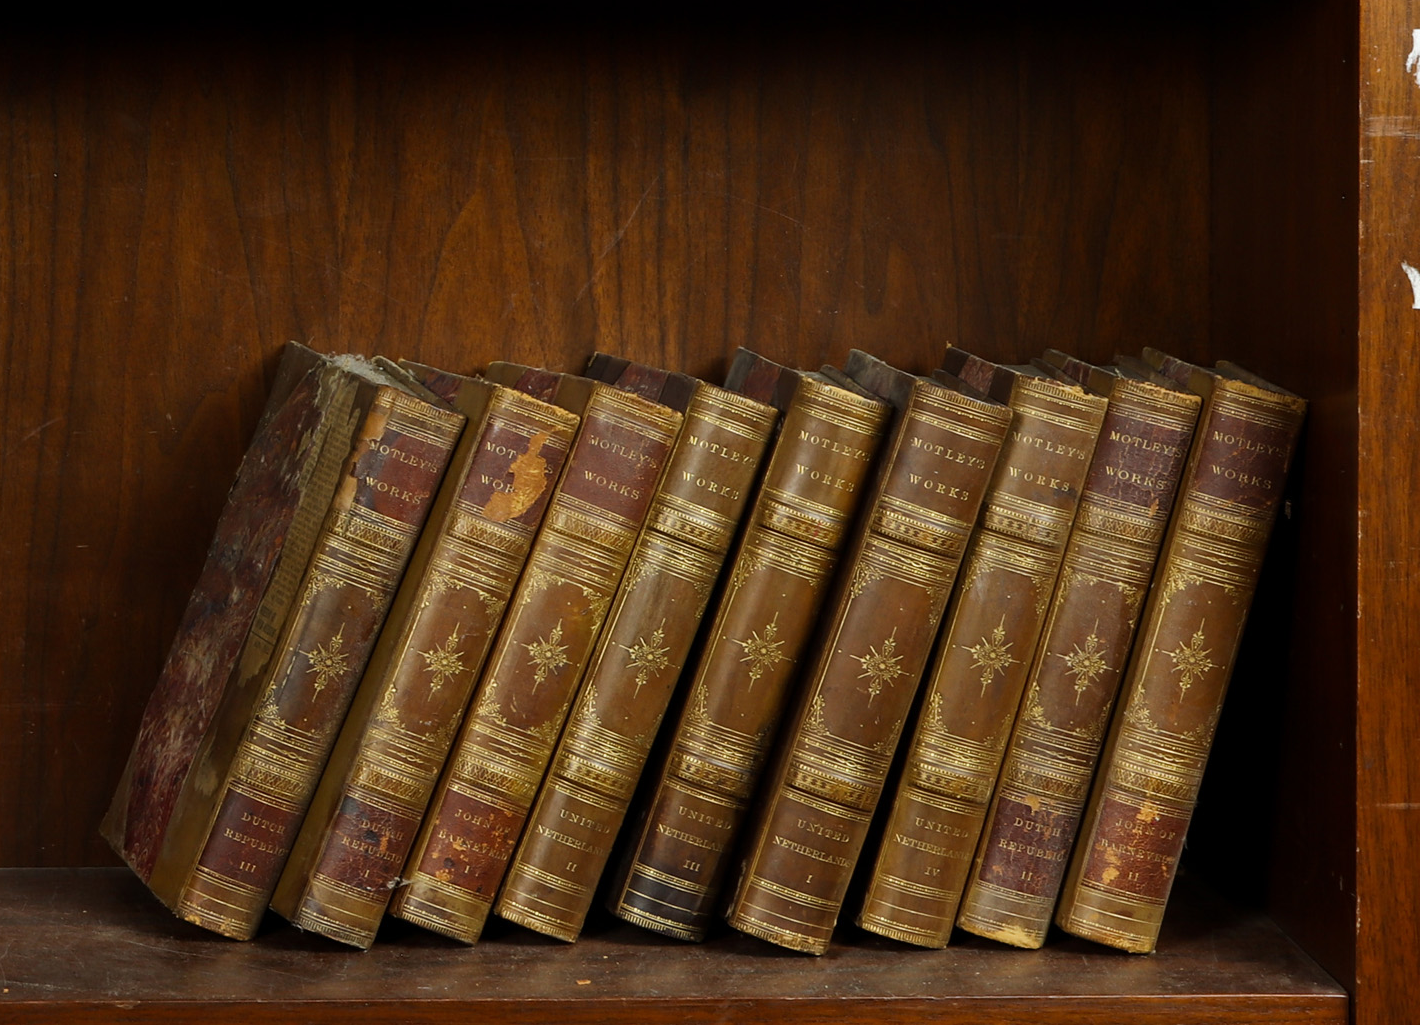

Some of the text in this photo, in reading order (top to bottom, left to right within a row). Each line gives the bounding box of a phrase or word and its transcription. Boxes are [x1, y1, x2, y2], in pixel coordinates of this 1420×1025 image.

[369, 439, 438, 474] MOTLEY'S
[587, 434, 657, 470] MOTLEY'S
[687, 435, 757, 469] MOTLEY'S
[799, 429, 871, 463] MOTLEY'S
[911, 436, 985, 470] MOTLEY'S
[1012, 431, 1086, 460] MOTLEY'S
[1109, 430, 1183, 459] MOTLEY'S
[1212, 430, 1285, 458] MOTLEY'S
[584, 470, 640, 501] WORKS
[681, 470, 740, 501] WORKS
[795, 463, 855, 493] WORKS
[909, 473, 970, 501] WORKS
[1009, 466, 1070, 492] WORKS
[1105, 465, 1165, 490] WORKS
[1211, 464, 1272, 490] WORKS
[365, 476, 421, 505] WORKS
[241, 811, 286, 835] DUTCH
[361, 819, 404, 841] DUTCH
[454, 808, 511, 835] JOHN OF
[560, 809, 611, 834] UNITED
[678, 806, 731, 830] UNITED
[797, 818, 850, 843] UNITED
[915, 816, 969, 838] UNITED
[1013, 817, 1062, 837] DUTCH
[1115, 817, 1176, 841] JOHN OF
[223, 827, 289, 857] REPUBLIC
[341, 836, 403, 864] REPUBLIC
[437, 830, 509, 861] BARNEVELD
[772, 834, 853, 868] NETHERLANDS
[998, 838, 1064, 862] REPUBLIC
[239, 861, 257, 873] III
[364, 868, 370, 879] I
[464, 865, 471, 875] I
[565, 861, 578, 873] II
[683, 860, 701, 872] III
[805, 874, 813, 884] I
[924, 866, 941, 877] IV
[1020, 871, 1033, 881] II
[1128, 871, 1140, 882] II
